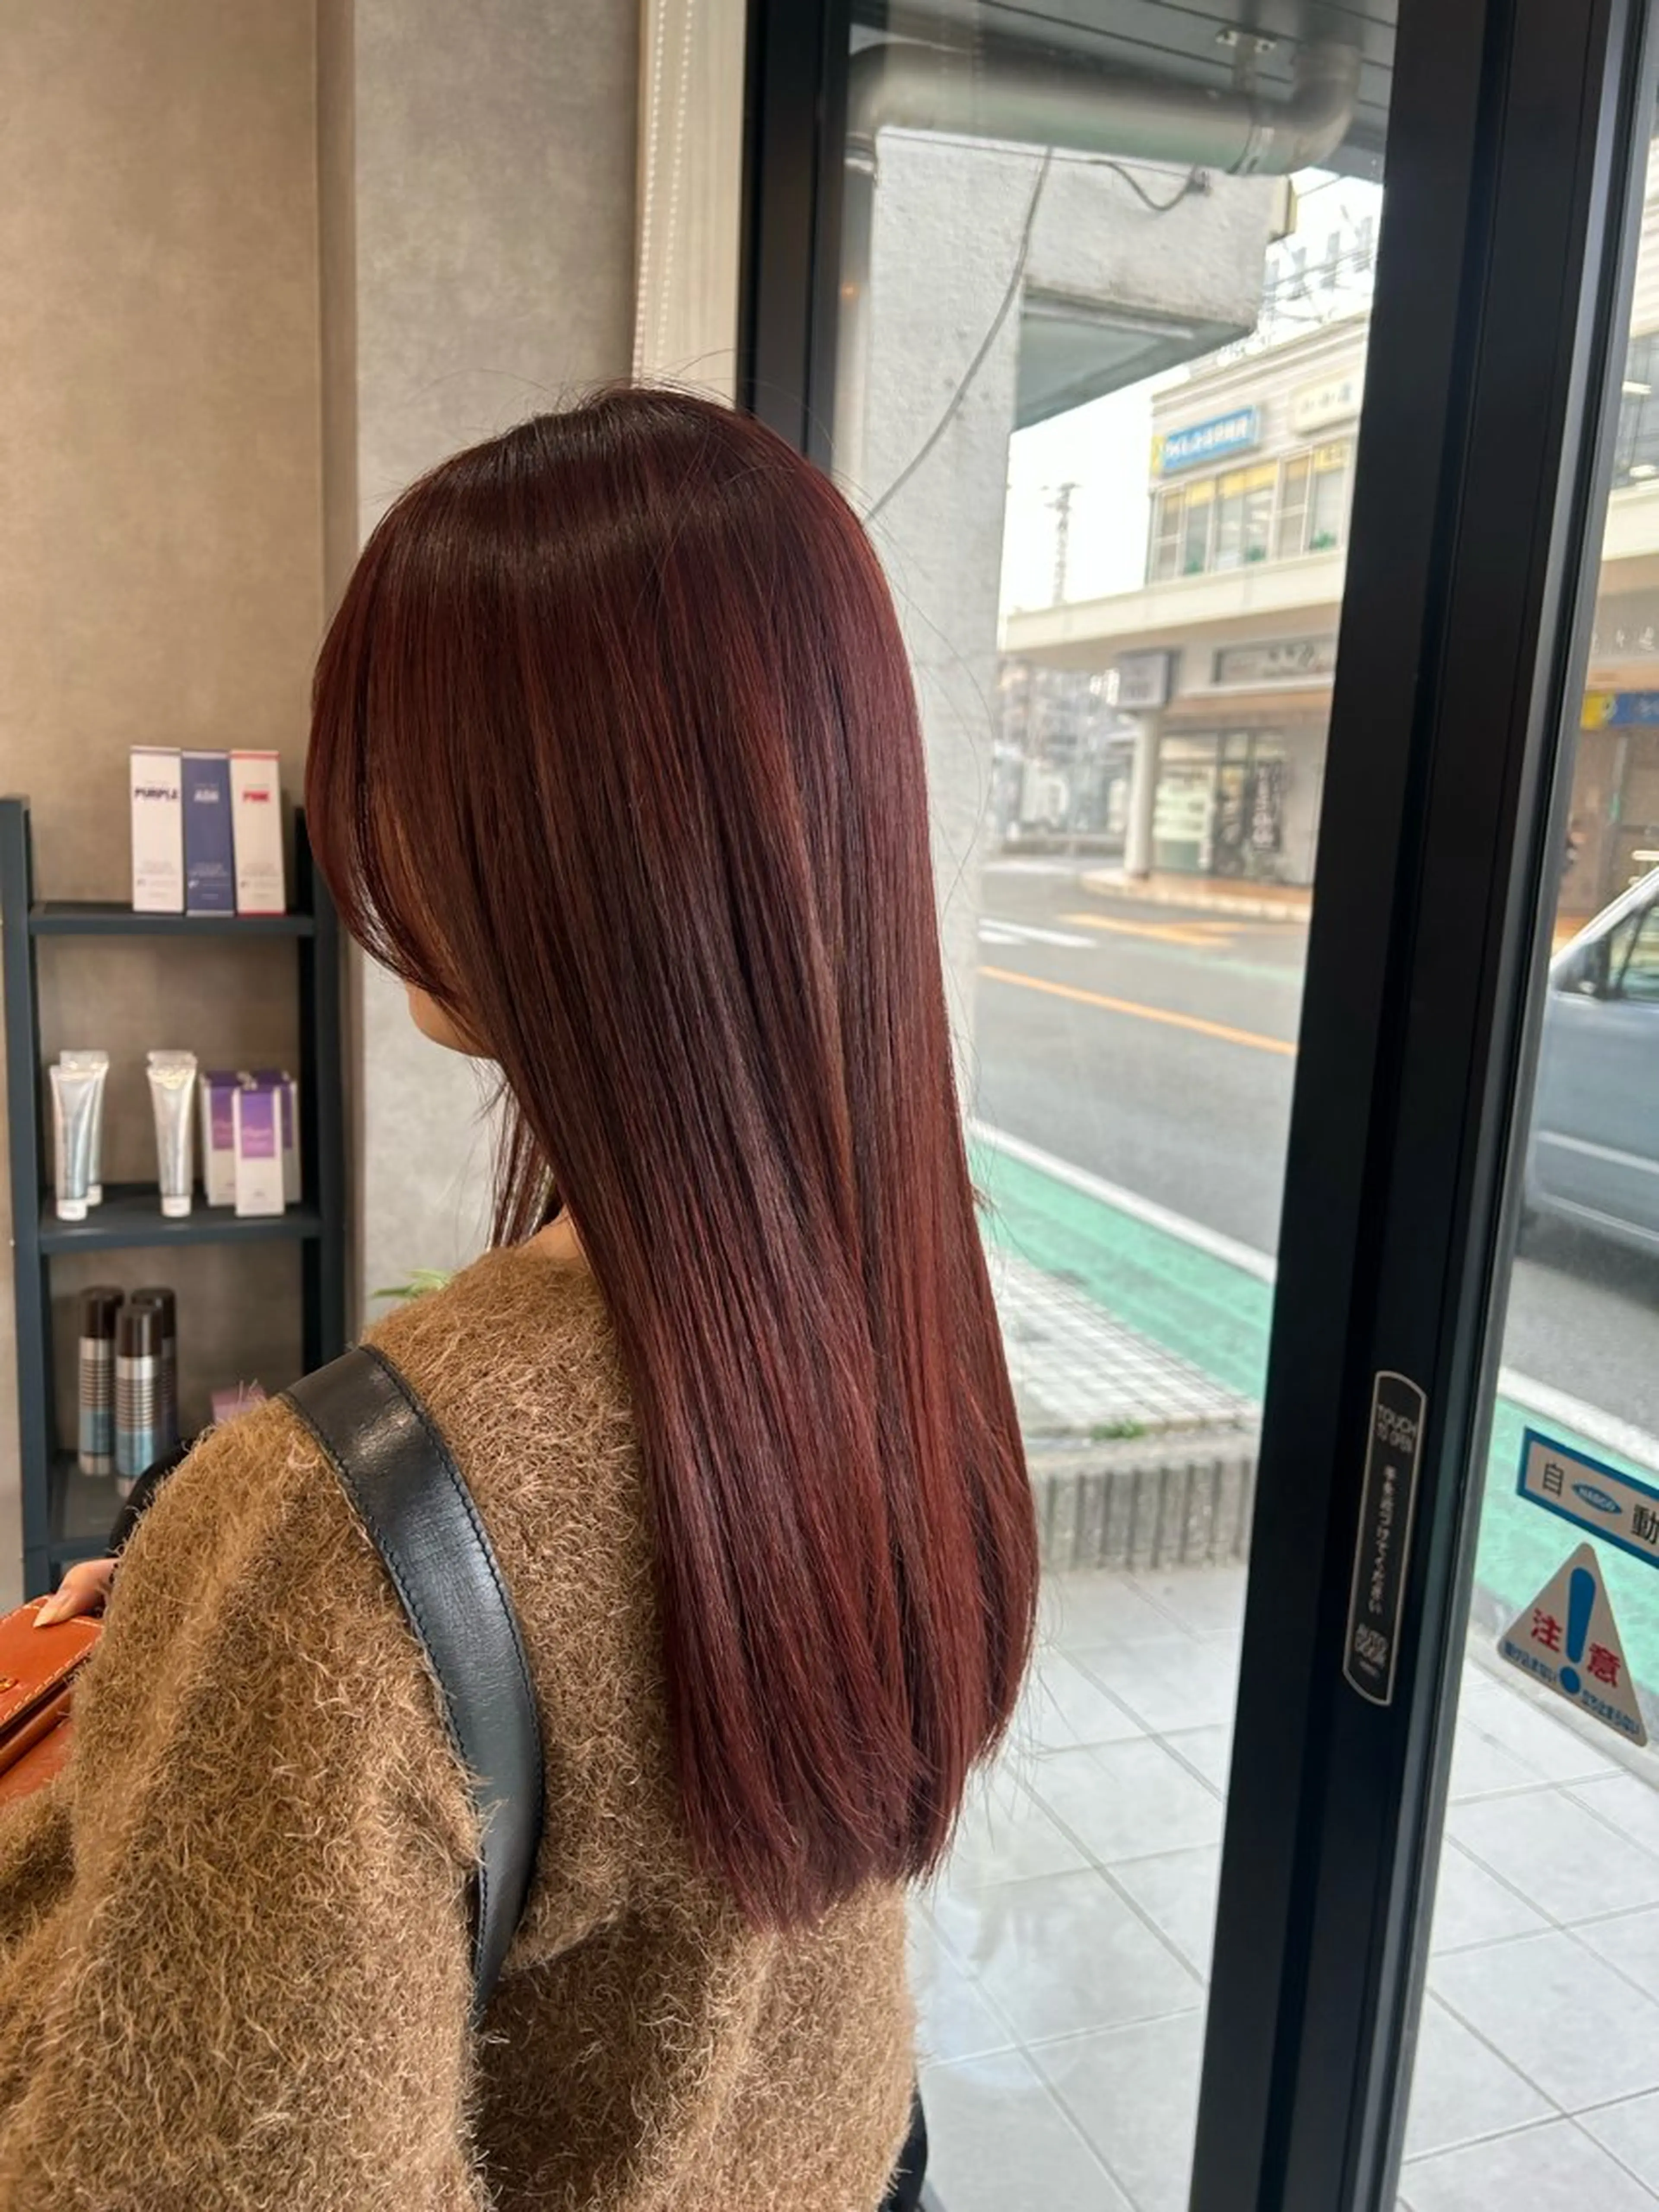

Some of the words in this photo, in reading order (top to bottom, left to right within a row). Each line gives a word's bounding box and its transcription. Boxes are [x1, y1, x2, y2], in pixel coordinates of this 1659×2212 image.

[134, 787, 178, 800] PURPLE
[1377, 1422, 1389, 1441] TO
[1389, 1429, 1414, 1453] OPEN
[1378, 1404, 1420, 1438] TOUCH
[1542, 1462, 1564, 1497] 自
[1630, 1503, 1659, 1545] 動
[1531, 1607, 1563, 1653] 注
[1586, 1642, 1621, 1688] 意
